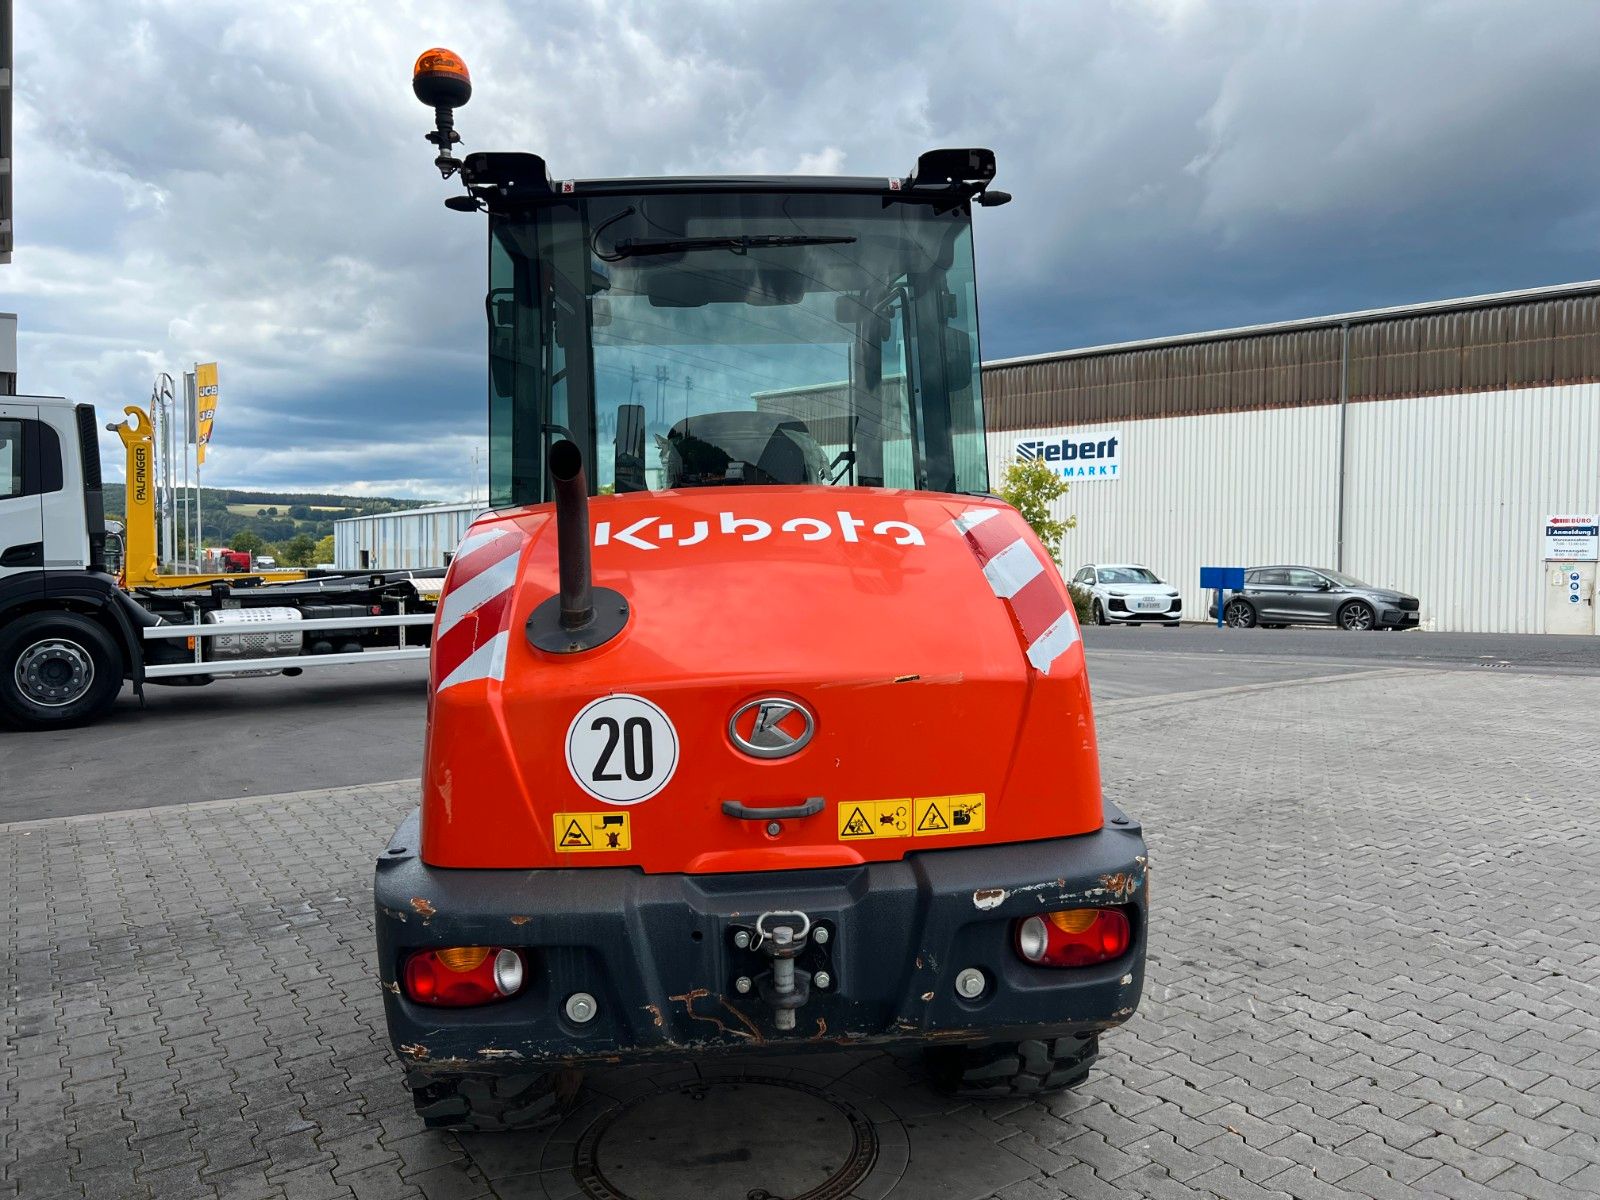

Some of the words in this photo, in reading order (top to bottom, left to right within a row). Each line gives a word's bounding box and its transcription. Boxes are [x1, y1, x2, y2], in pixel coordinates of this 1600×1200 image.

[200, 386, 217, 396] JCB
[200, 410, 213, 420] JB
[1016, 436, 1118, 464] Siebert
[136, 447, 146, 501] PALFINGER
[594, 510, 926, 551] Kubota
[591, 716, 654, 782] 20
